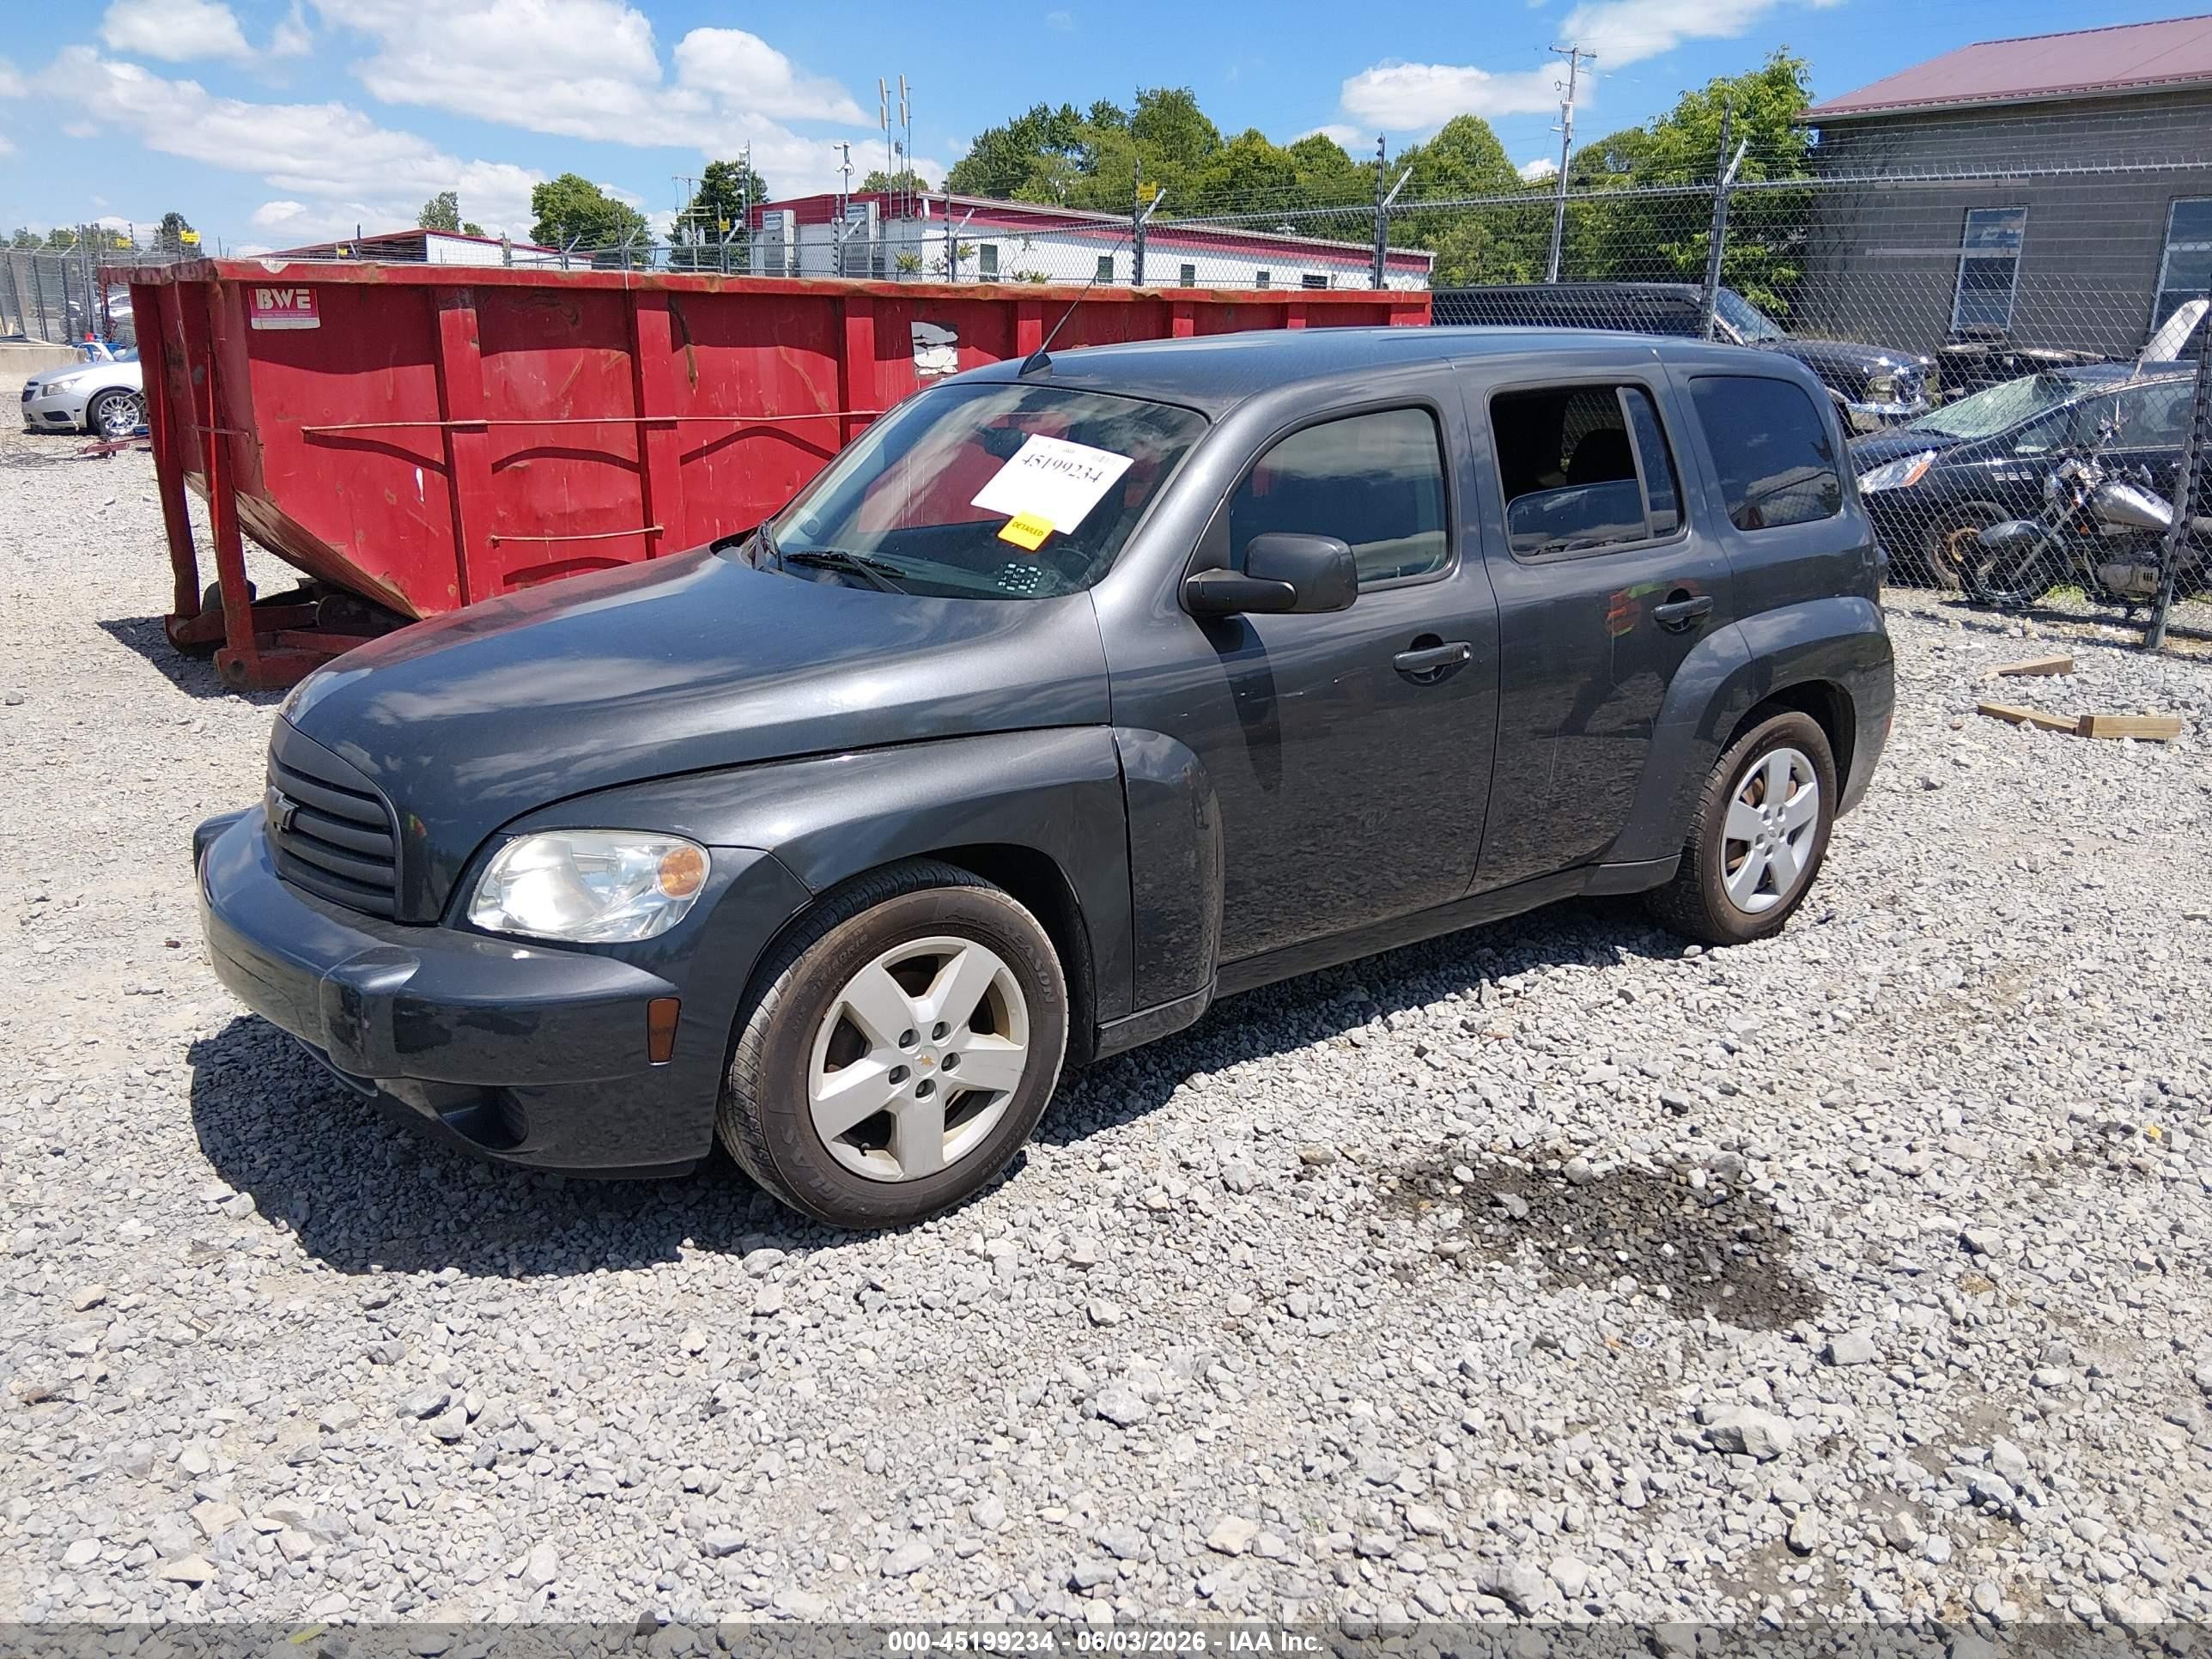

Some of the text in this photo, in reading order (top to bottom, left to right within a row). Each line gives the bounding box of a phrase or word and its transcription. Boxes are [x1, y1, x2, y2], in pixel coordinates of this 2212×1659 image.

[255, 289, 311, 310] BWE
[1022, 453, 1103, 483] 45199234
[1012, 521, 1044, 537] DETAILED
